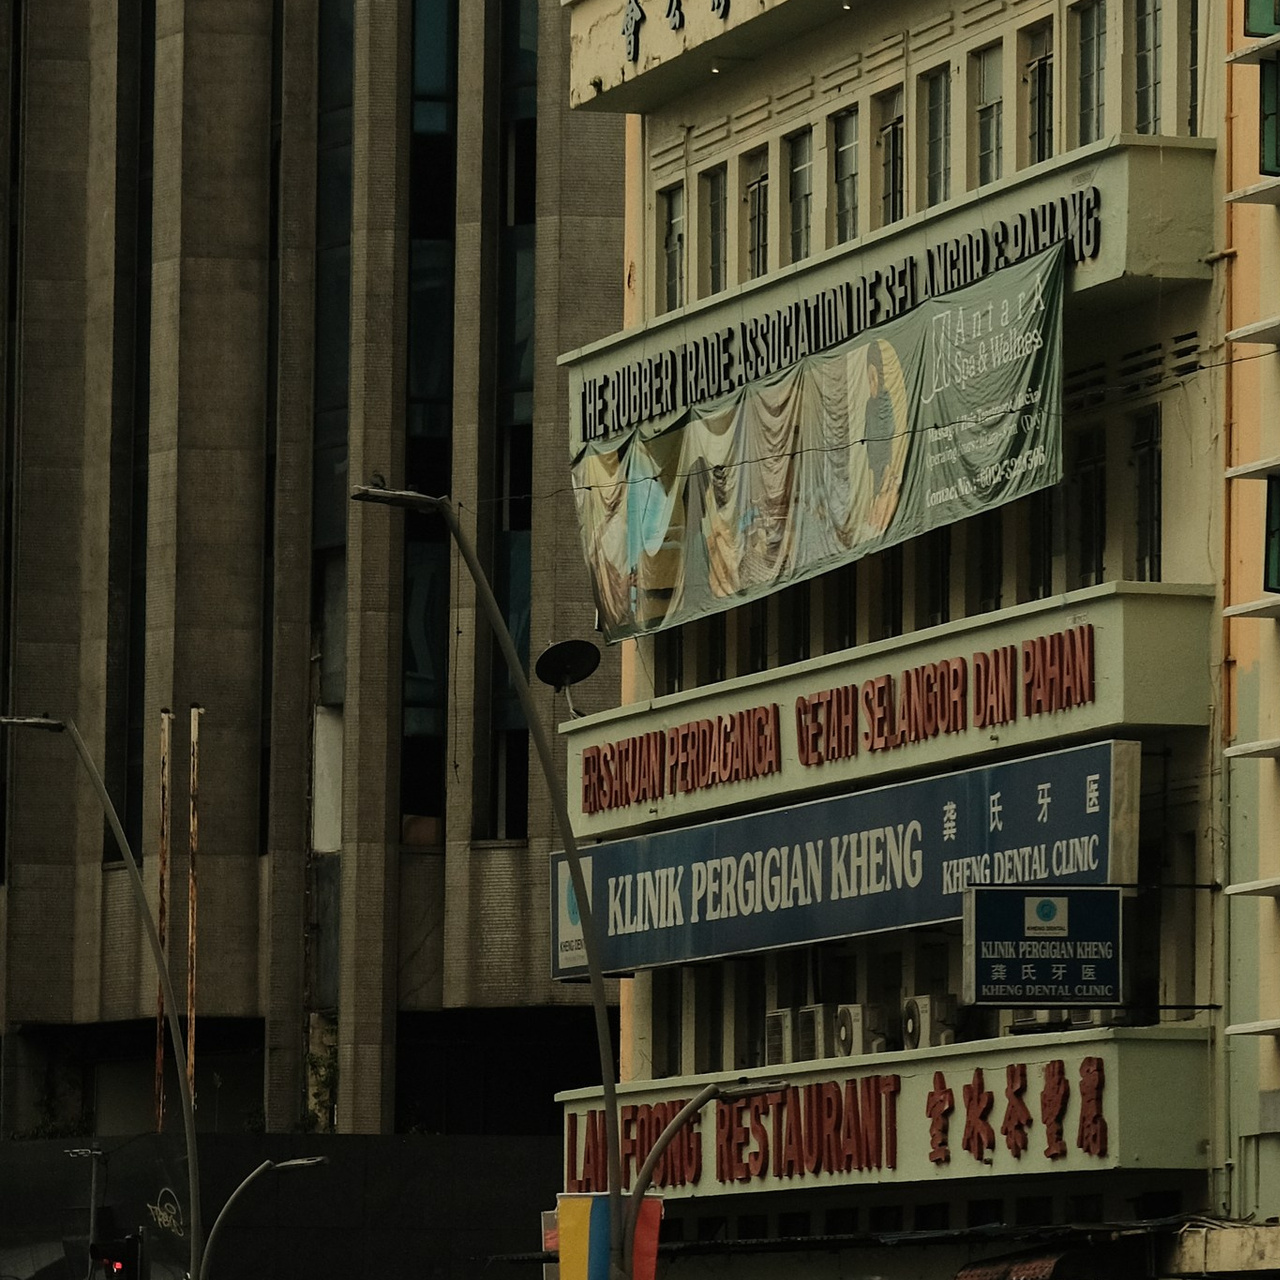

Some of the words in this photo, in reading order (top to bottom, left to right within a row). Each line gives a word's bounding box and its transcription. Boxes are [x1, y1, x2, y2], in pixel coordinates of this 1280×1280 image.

[581, 374, 609, 442] THE
[609, 350, 677, 432] RUBBER
[676, 327, 734, 406] TRADE
[736, 282, 850, 386] ASSOCIATION
[852, 270, 881, 333] OF
[993, 220, 1009, 270] &
[1012, 186, 1101, 261] PAHANG
[955, 351, 976, 390] Spa
[979, 341, 988, 373] &
[582, 730, 666, 814] ERSATUAN
[667, 703, 782, 795] PERDAGANGA
[795, 684, 858, 766] GETAH
[861, 656, 967, 752] SELANGOR
[973, 644, 1017, 728] DAN
[1022, 623, 1095, 718] PAHAN
[608, 866, 684, 936] KLINIK
[690, 839, 823, 923] PERGIGIAN
[830, 820, 923, 900] KHENG
[943, 853, 990, 895] KHENG
[994, 844, 1049, 884] DENTAL
[1052, 834, 1099, 876] CLINIC
[981, 941, 1016, 959] KLINIK
[1019, 941, 1074, 959] PERGIGIAN
[1076, 941, 1113, 959] KHENG
[982, 985, 1022, 996] KHENG
[1026, 985, 1071, 996] DENTAL
[1075, 985, 1113, 996] CLINIC
[621, 1099, 702, 1190] FOONG
[715, 1074, 900, 1184] RESTAURANT
